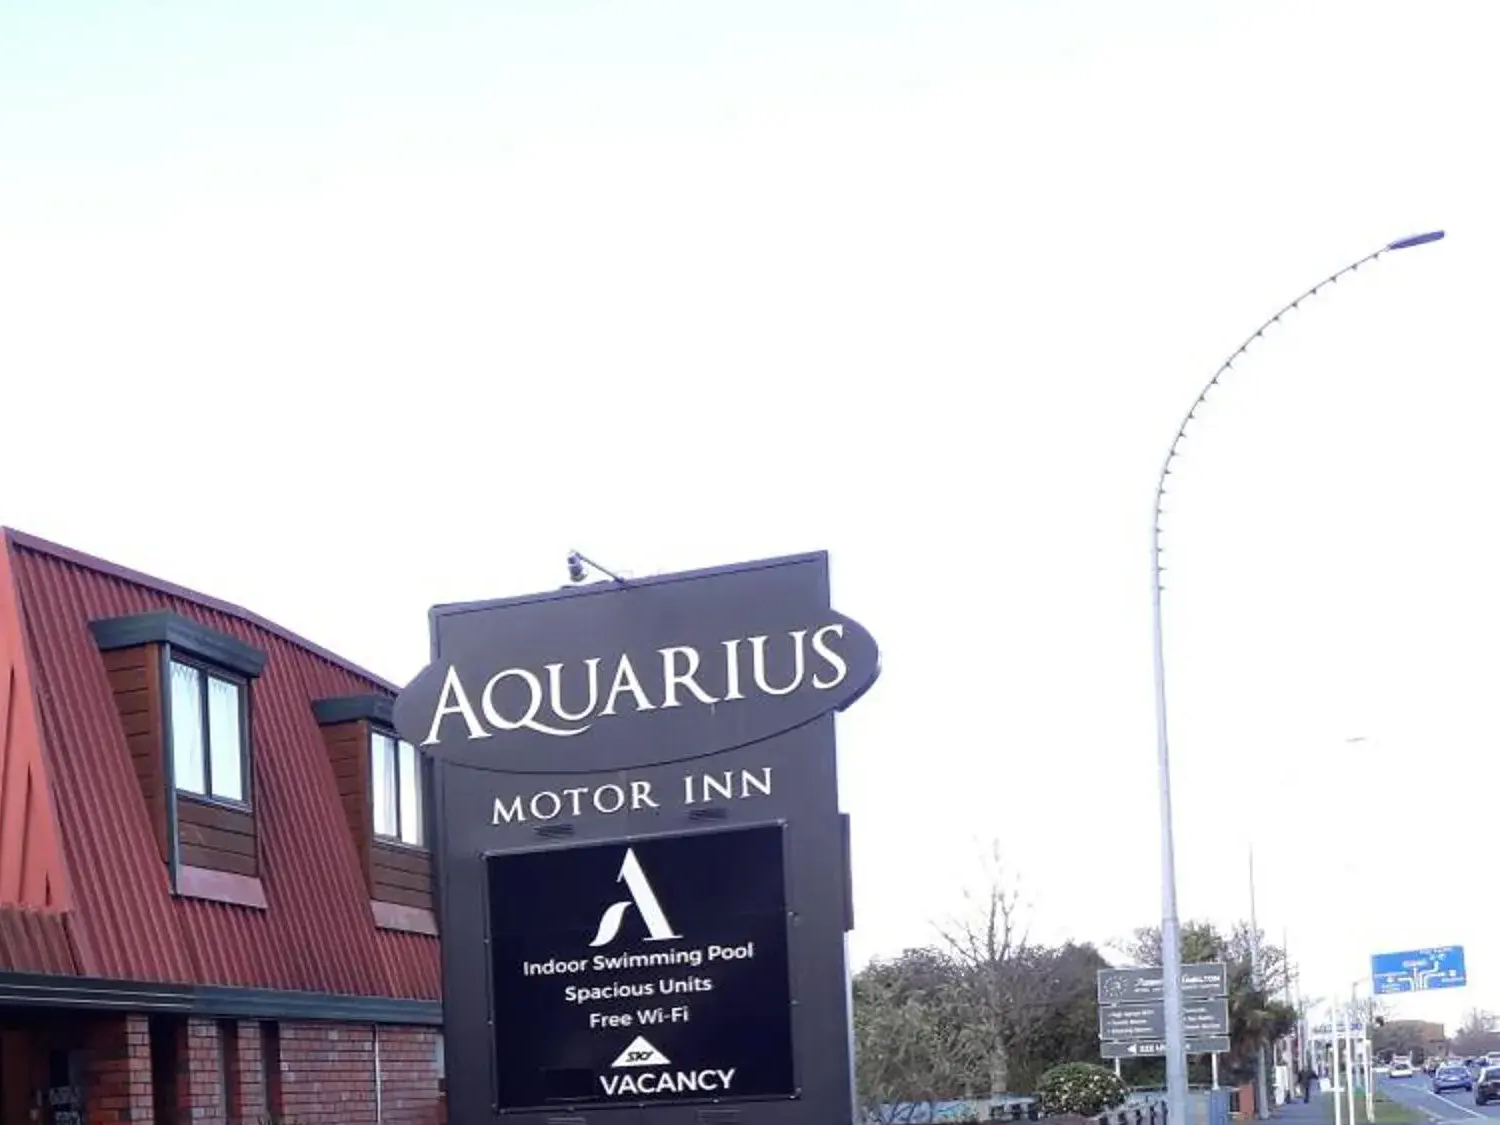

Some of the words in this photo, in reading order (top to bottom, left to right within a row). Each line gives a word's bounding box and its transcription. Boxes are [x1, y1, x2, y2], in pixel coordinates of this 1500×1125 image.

[419, 623, 848, 747] AQUARIUS
[491, 779, 659, 825] MOTOR
[683, 766, 773, 805] INN
[522, 958, 588, 976] Indoor
[592, 948, 703, 971] Swimming
[707, 941, 754, 961] Pool
[564, 982, 654, 1004] Spacious
[659, 976, 713, 995] Units
[589, 1012, 633, 1028] Free
[636, 1005, 690, 1026] Wi-Fi
[599, 1067, 737, 1096] VACANCY
